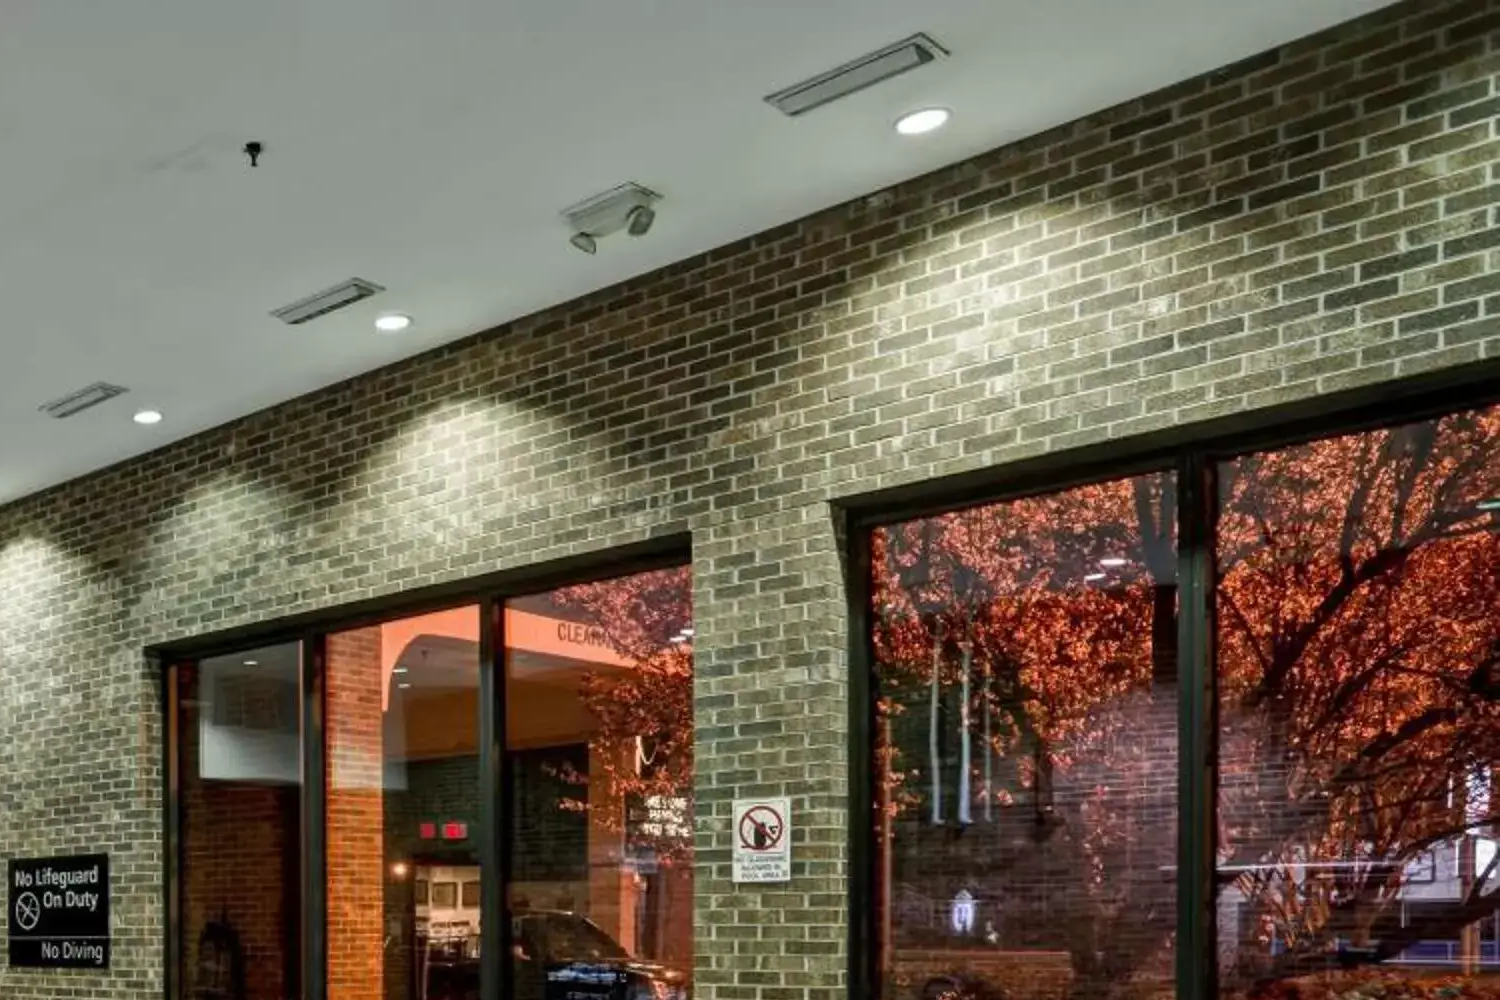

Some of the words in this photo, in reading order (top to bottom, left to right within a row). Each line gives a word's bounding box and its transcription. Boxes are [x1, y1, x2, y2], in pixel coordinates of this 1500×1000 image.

[15, 869, 33, 887] No
[35, 865, 98, 889] Lifeguard
[43, 891, 62, 908] On
[65, 891, 98, 912] Duty
[42, 941, 59, 959] No
[63, 941, 103, 965] Diving
